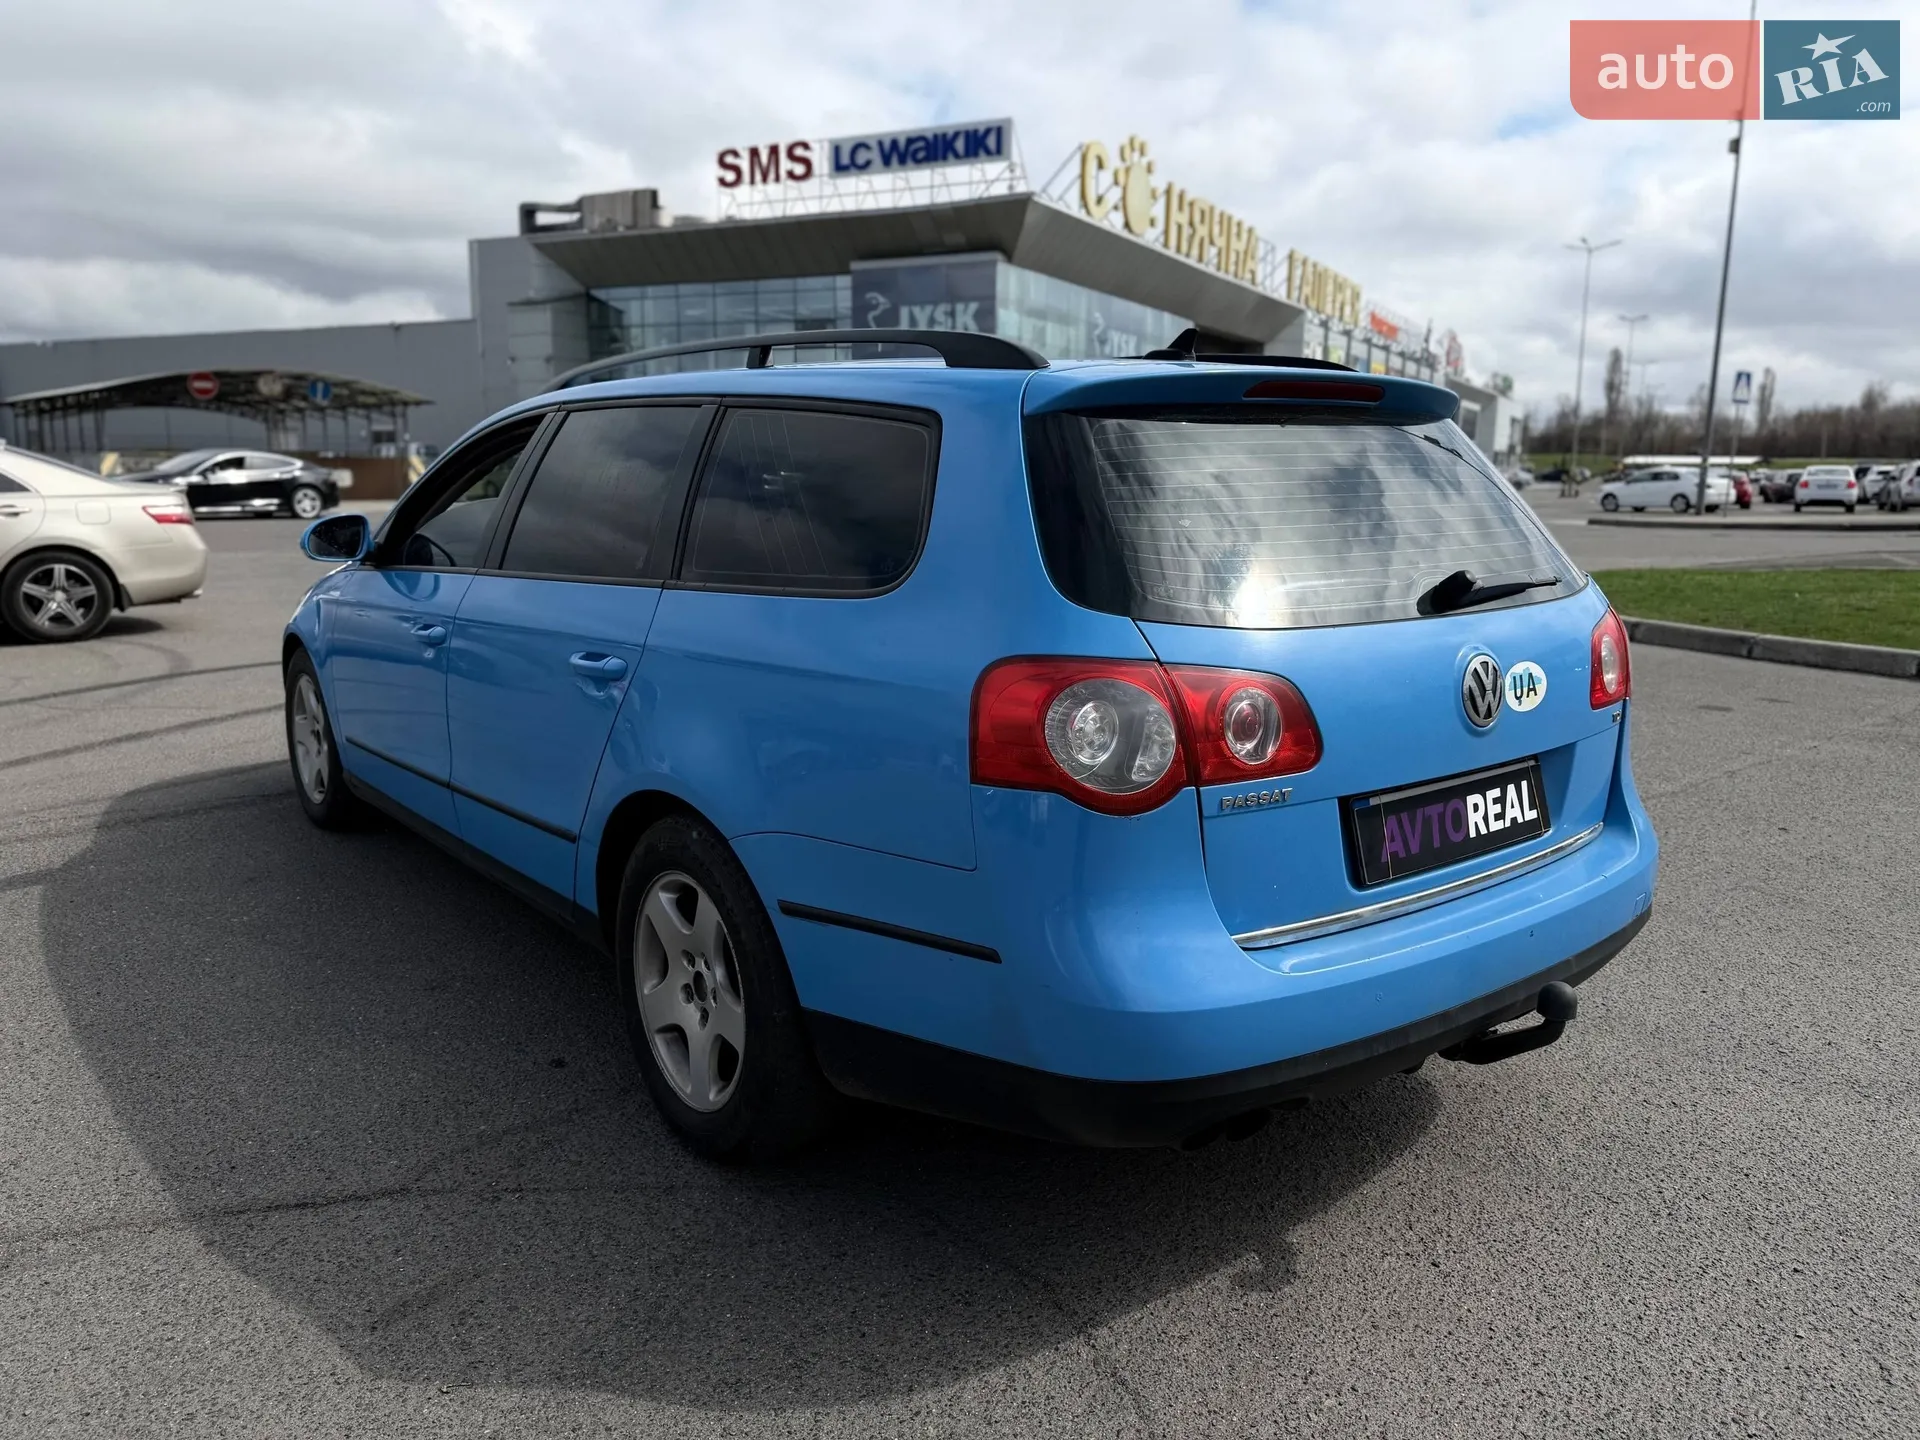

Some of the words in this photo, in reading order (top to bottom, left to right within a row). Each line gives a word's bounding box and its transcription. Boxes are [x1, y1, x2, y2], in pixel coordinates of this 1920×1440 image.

[717, 141, 813, 188] SMS
[834, 142, 872, 173] LC
[1221, 787, 1293, 810] PASSAT
[1381, 780, 1538, 863] AVTOREAL
